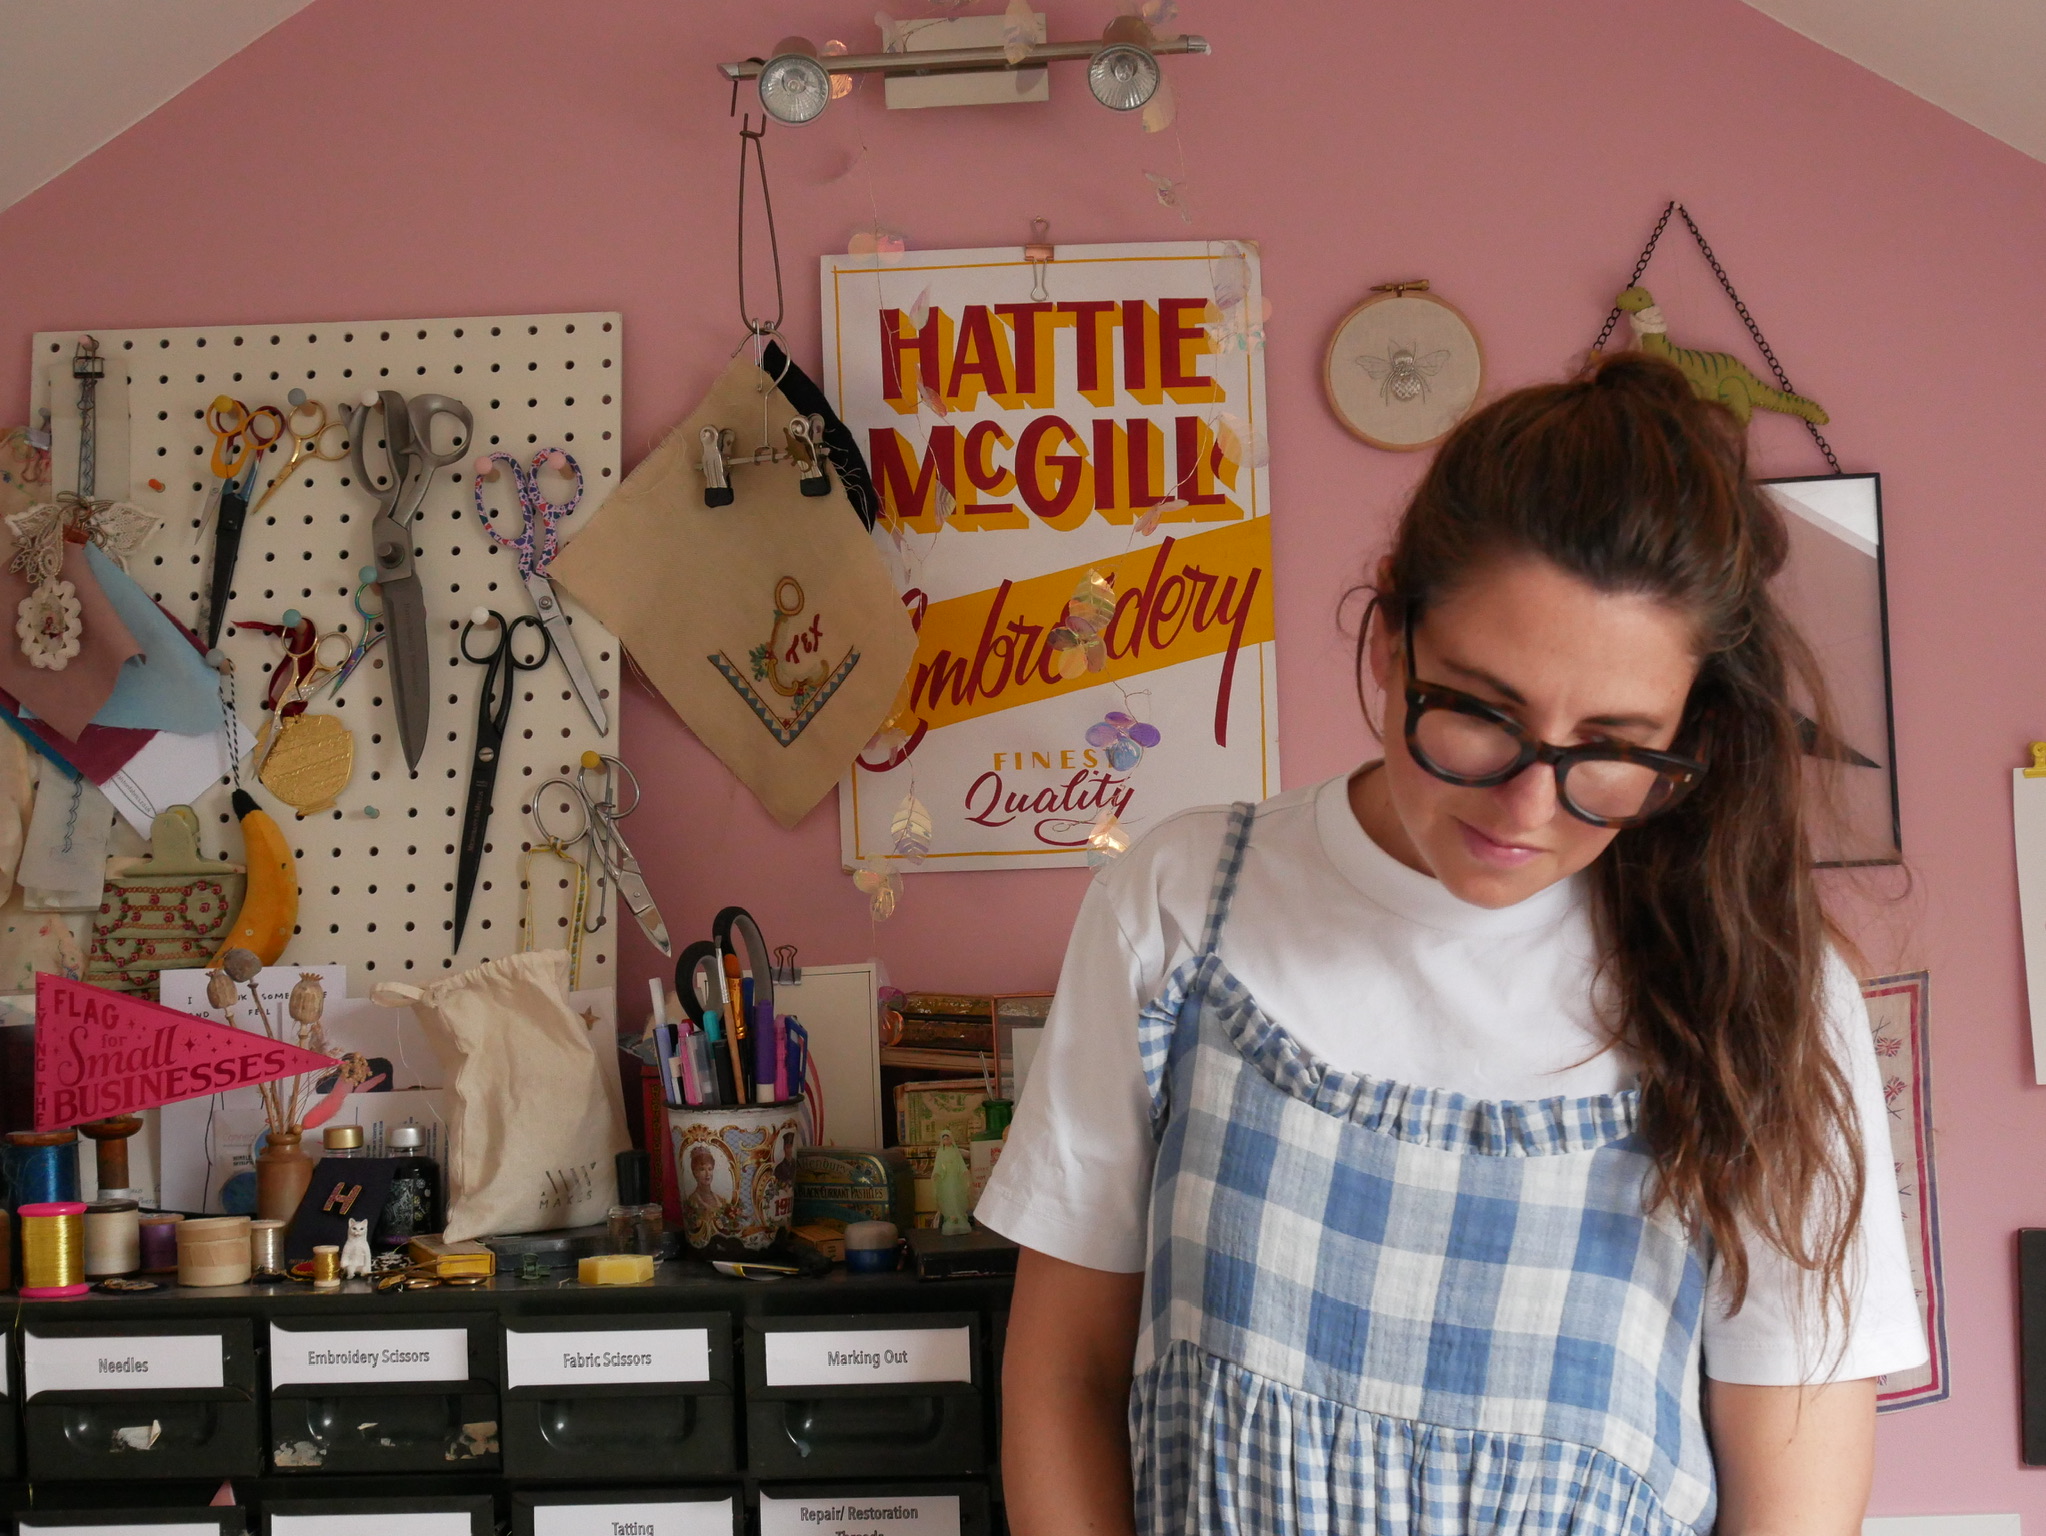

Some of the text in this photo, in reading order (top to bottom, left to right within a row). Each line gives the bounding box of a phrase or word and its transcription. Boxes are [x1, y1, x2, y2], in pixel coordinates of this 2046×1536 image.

[879, 298, 1220, 410] HATTIE
[993, 748, 1114, 771] FINES
[965, 768, 1136, 847] Quality
[54, 989, 119, 1030] FLAG
[101, 1034, 127, 1048] for
[36, 982, 47, 1127] FLYING THE
[58, 1023, 180, 1087] Small
[54, 1050, 285, 1125] BUSINESSES
[323, 1181, 363, 1215] H
[99, 1357, 149, 1373] Needles
[308, 1349, 430, 1368] Embroidery Scissors
[563, 1352, 652, 1368] Fabric Scissors
[827, 1349, 908, 1369] Marking Out
[800, 1505, 919, 1525] Repair/ Restoration
[611, 1521, 654, 1536] Tatting
